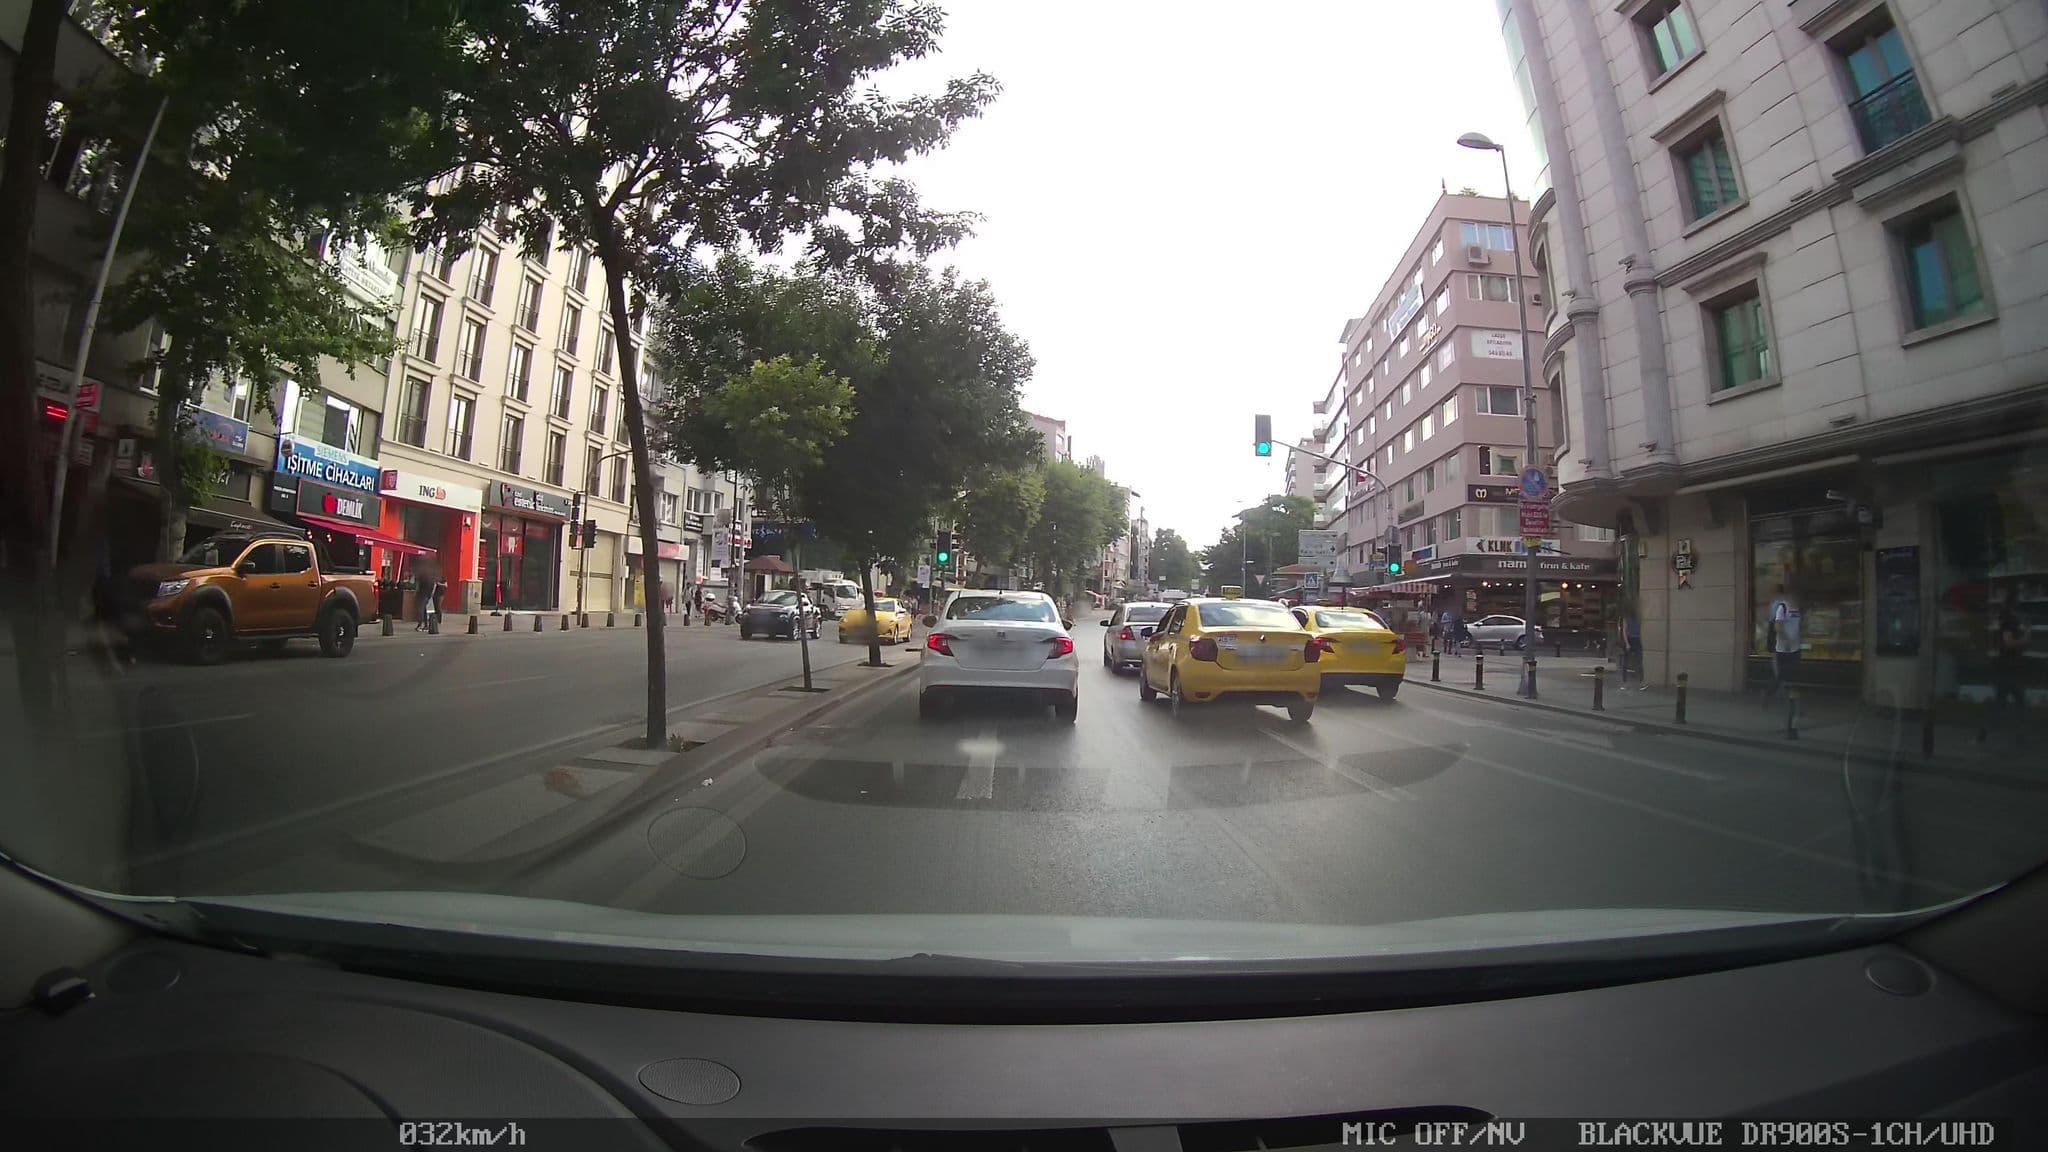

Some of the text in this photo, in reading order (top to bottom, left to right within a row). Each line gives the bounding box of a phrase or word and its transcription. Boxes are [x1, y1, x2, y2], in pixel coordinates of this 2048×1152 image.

[325, 463, 375, 492] CİHAZLARI
[418, 485, 435, 498] ING
[337, 499, 364, 520] DEMLİK
[1498, 560, 1528, 569] nam
